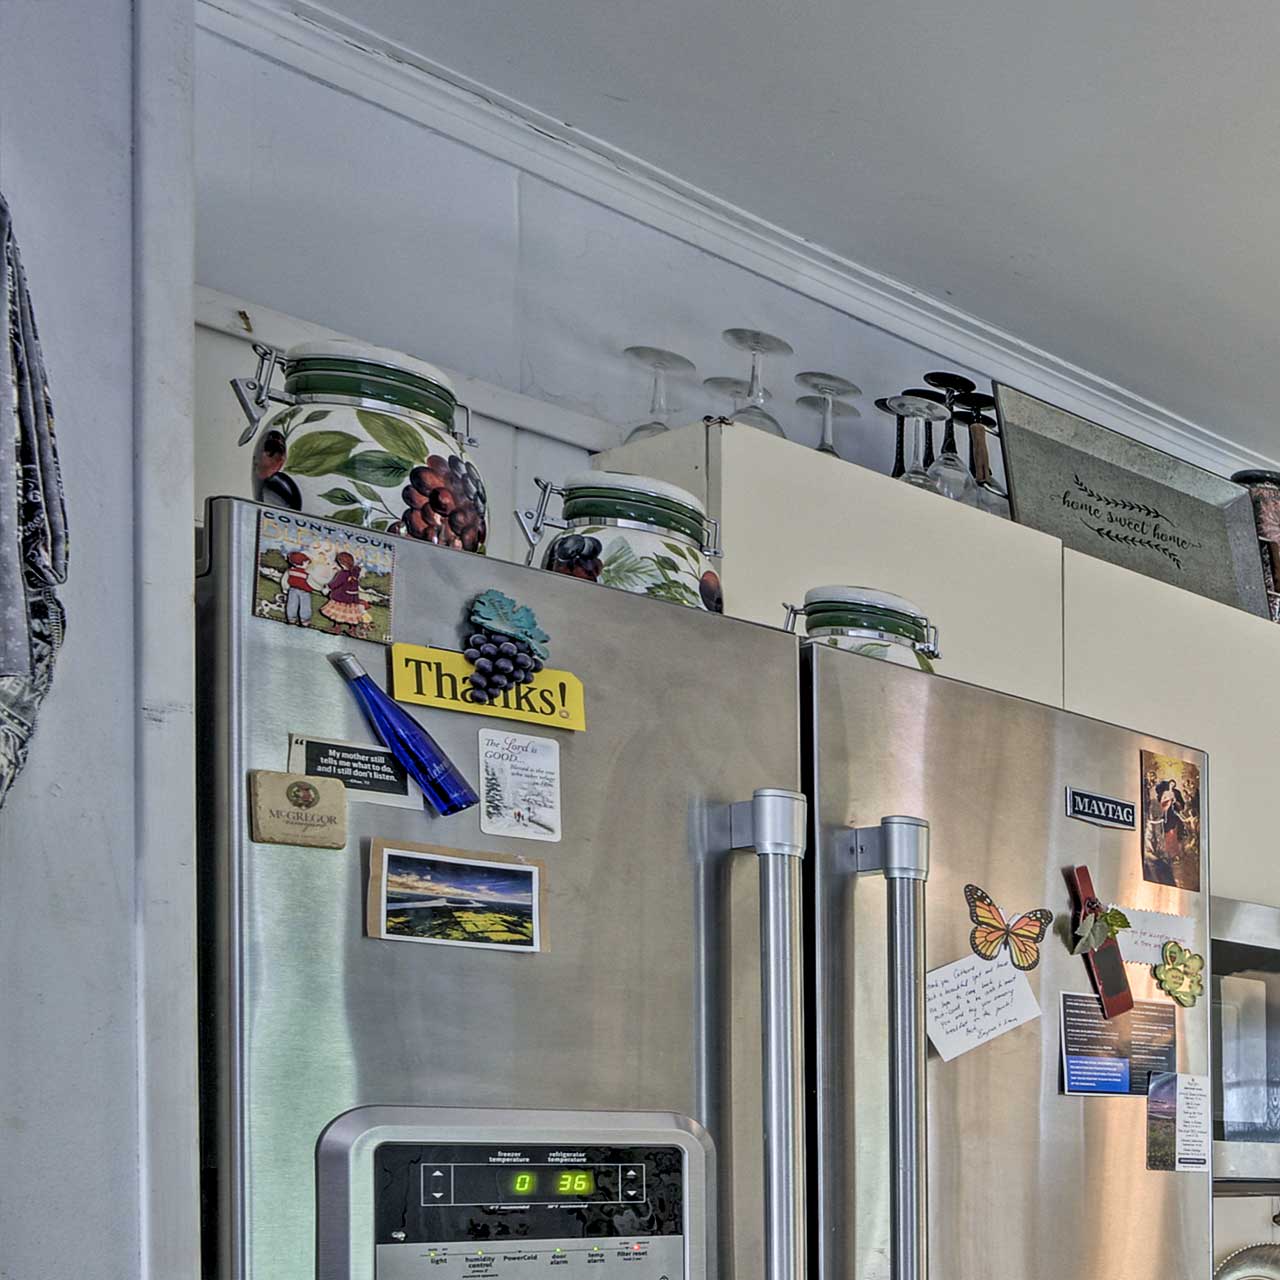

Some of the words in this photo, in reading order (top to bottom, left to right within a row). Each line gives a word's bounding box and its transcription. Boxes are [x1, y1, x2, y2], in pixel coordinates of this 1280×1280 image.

[1060, 490, 1103, 521] home
[1106, 510, 1150, 535] sweet
[1153, 522, 1194, 551] home
[262, 511, 337, 535] COUNT
[342, 531, 394, 551] YOUR
[484, 737, 501, 748] The
[502, 736, 535, 754] Lord
[320, 756, 338, 766] tells
[338, 759, 351, 767] me
[352, 761, 371, 770] what
[328, 749, 341, 759] My
[341, 752, 369, 762] mother
[370, 756, 385, 764] still
[316, 765, 332, 773] and
[337, 767, 352, 776] still
[353, 769, 373, 778] don't
[1074, 795, 1133, 822] MAYTAG
[515, 1174, 530, 1191] 0
[558, 1174, 586, 1191] 36
